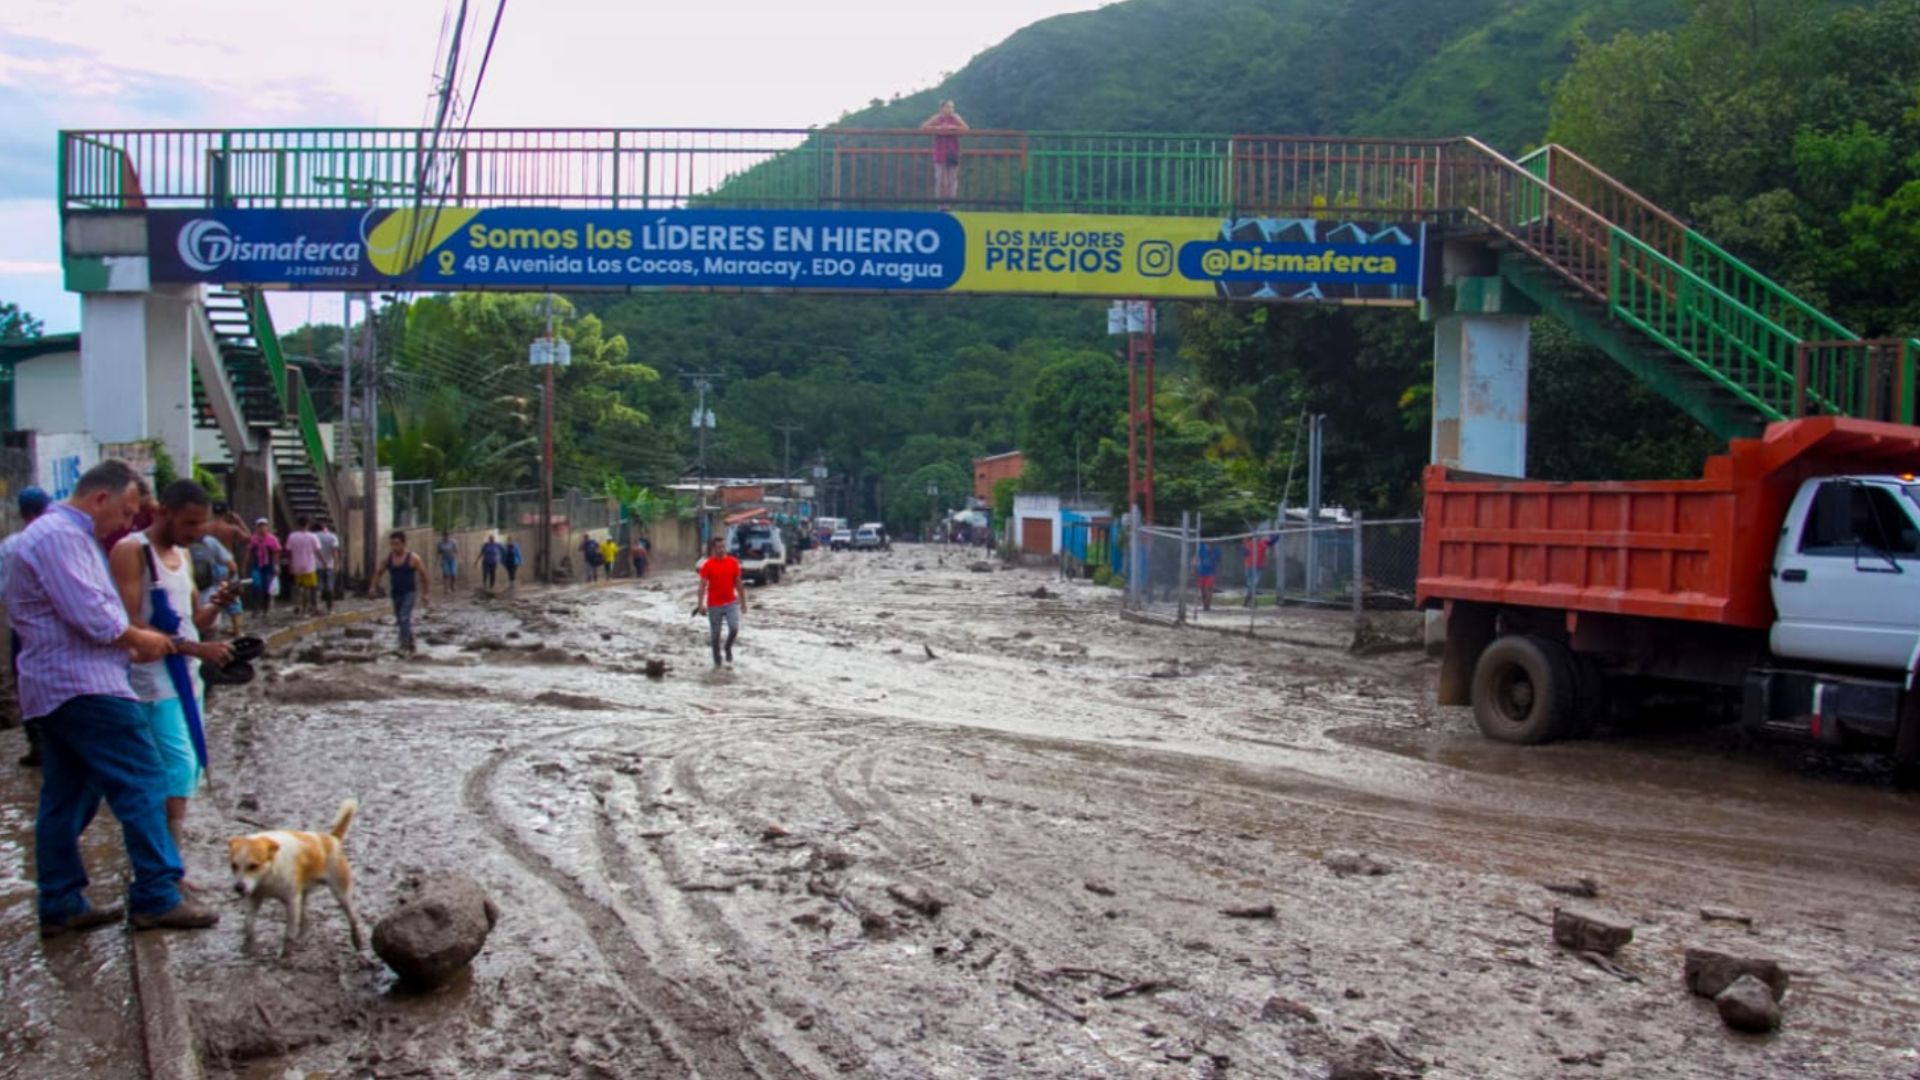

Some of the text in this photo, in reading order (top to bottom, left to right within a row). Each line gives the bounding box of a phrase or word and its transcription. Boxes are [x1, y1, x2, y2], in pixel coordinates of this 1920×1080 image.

[202, 235, 359, 263] Dismaferca
[469, 218, 941, 254] Somos los LÍDERES EN HIERRO
[986, 230, 1125, 248] LOS MEJORES
[464, 254, 943, 282] 49 Avenida Los Cocos, Maracay. EDO Aragua
[986, 247, 1122, 273] PRECIOS
[1202, 249, 1397, 273] @Dismaferca
